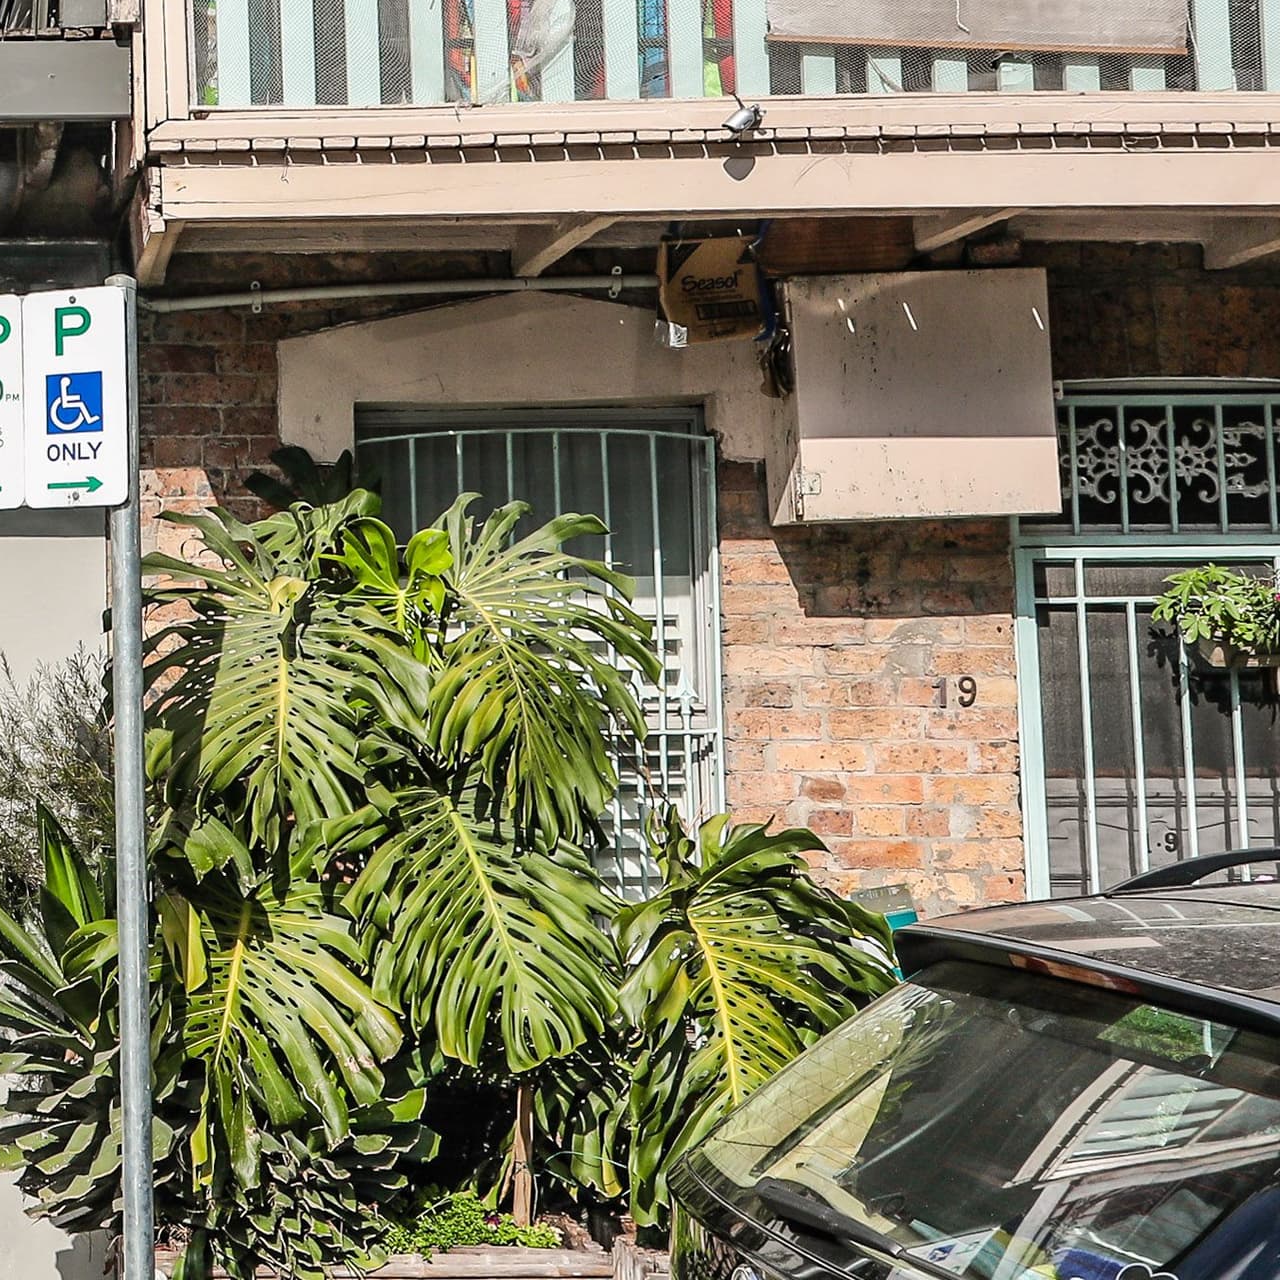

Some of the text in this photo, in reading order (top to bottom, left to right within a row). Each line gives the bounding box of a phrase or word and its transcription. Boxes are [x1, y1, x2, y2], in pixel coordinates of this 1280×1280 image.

[681, 271, 739, 292] Seasol
[54, 305, 92, 357] P
[46, 441, 103, 462] ONLY
[931, 676, 977, 709] 19
